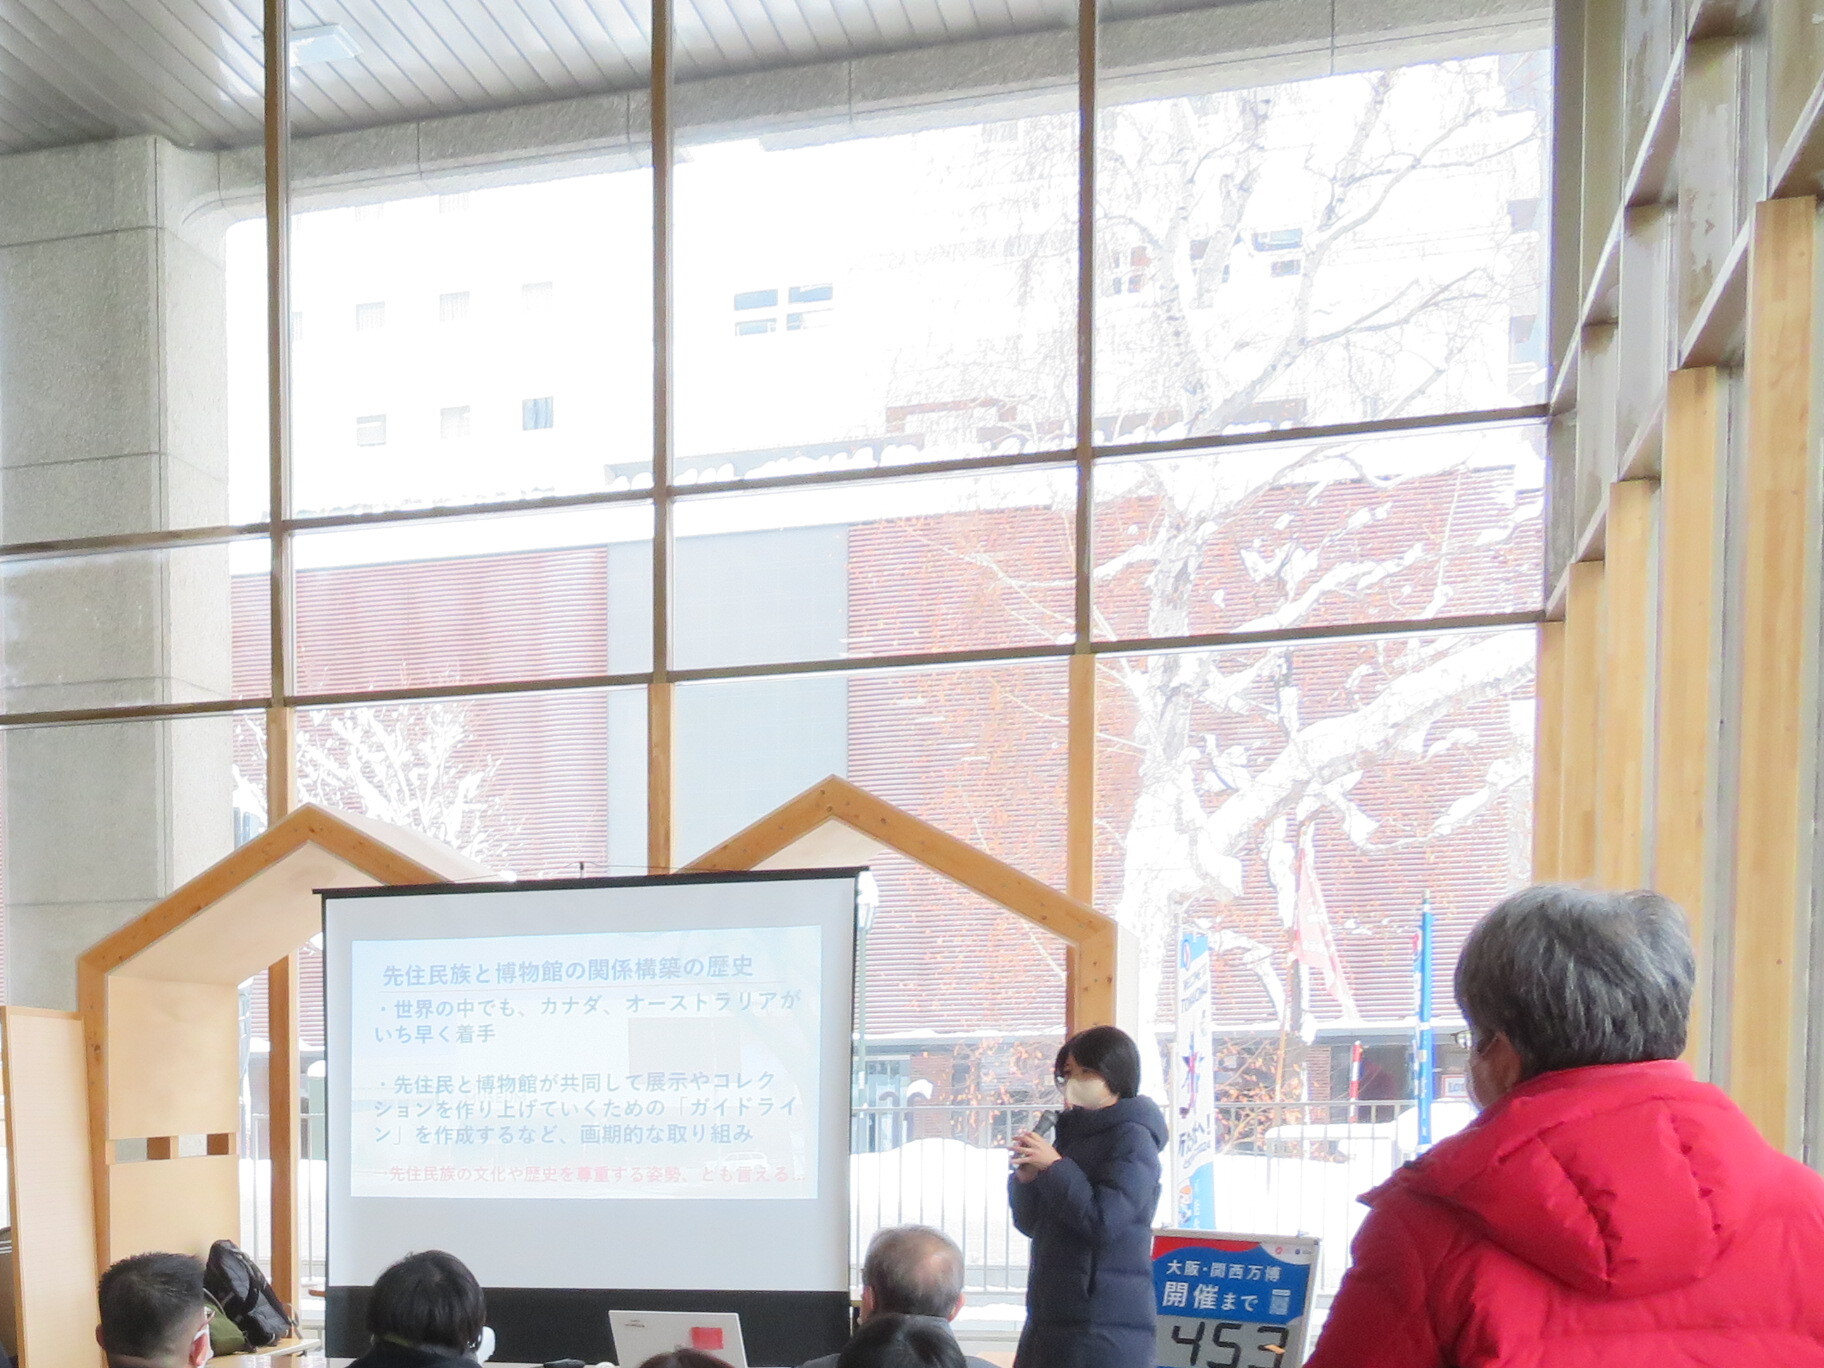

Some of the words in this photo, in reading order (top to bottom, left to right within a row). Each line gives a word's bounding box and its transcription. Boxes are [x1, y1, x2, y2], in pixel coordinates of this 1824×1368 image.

[382, 953, 754, 987] 先住民族と博物館の関係構築の歴史
[374, 1023, 497, 1045] いち早く着手
[373, 1096, 798, 1119] ションを作り上げていくための「ガイドライ
[374, 1123, 754, 1146] ン」を作成するなど、画期的な取り組み
[1165, 1259, 1282, 1282] 大阪・関西万博
[1162, 1281, 1259, 1312] 開催まで
